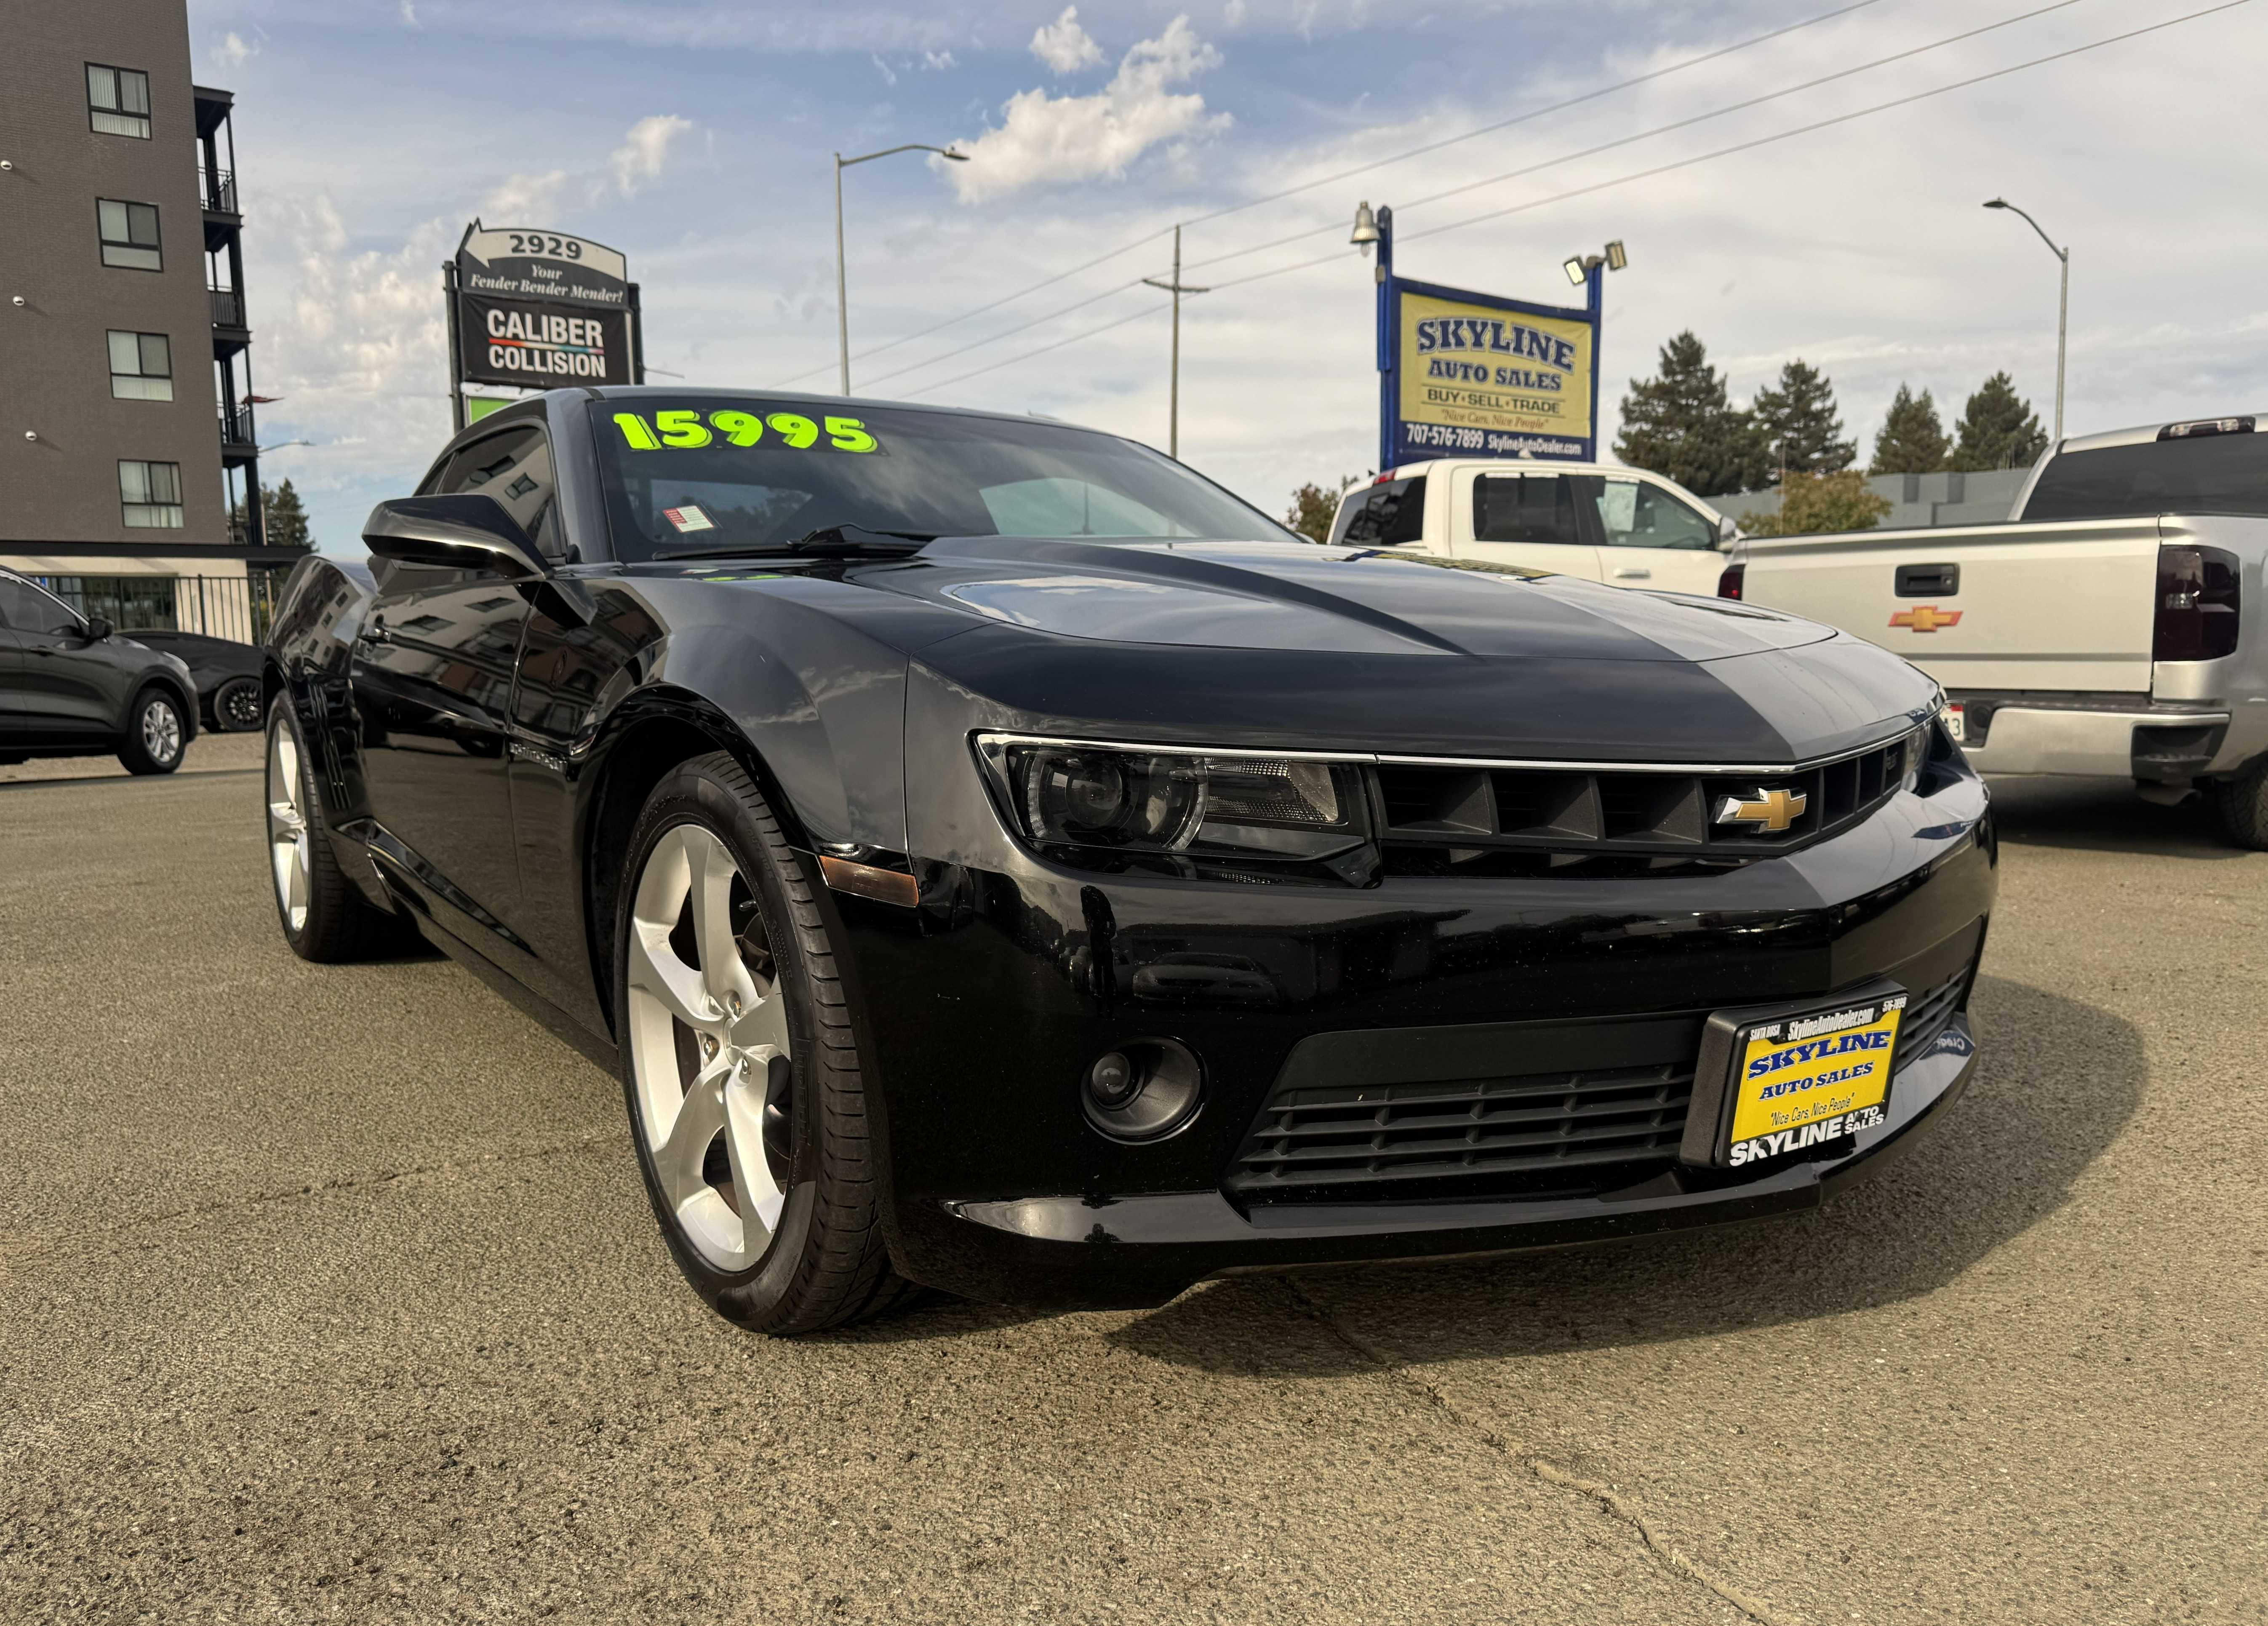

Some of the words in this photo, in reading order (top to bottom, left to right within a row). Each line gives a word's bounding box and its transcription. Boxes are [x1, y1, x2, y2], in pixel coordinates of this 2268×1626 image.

[510, 235, 582, 259] 2929
[471, 273, 518, 291] Fender
[520, 280, 568, 296] Bender
[571, 285, 624, 302] Mender!
[531, 264, 562, 278] Your
[487, 309, 604, 347] CALIBER
[489, 344, 606, 378] COLLISION
[1416, 317, 1576, 375] SKYLINE
[1428, 358, 1489, 383] AUTO
[1495, 366, 1562, 391] SALES
[1428, 389, 1460, 403] BUY
[1468, 394, 1503, 408] SELL
[1511, 399, 1559, 414] TRADE
[613, 410, 878, 452] 15995
[1492, 414, 1513, 426] Nice
[1406, 423, 1484, 449] 707-576-7899
[1488, 434, 1582, 456] SkylineAutoDealer.com
[1749, 1027, 1766, 1041] SANTA
[1766, 1024, 1781, 1038] ROSA
[1788, 1007, 1874, 1041] SkylineAutoDealer.com
[1748, 1030, 1892, 1080] SKYLINE
[1758, 1076, 1815, 1101] AUTO
[1816, 1061, 1874, 1087] SALES
[1791, 1107, 1809, 1121] Cars,
[1812, 1102, 1827, 1116] Nice
[1844, 1113, 1884, 1135] SALES
[1729, 1116, 1844, 1167] SKYLINE
